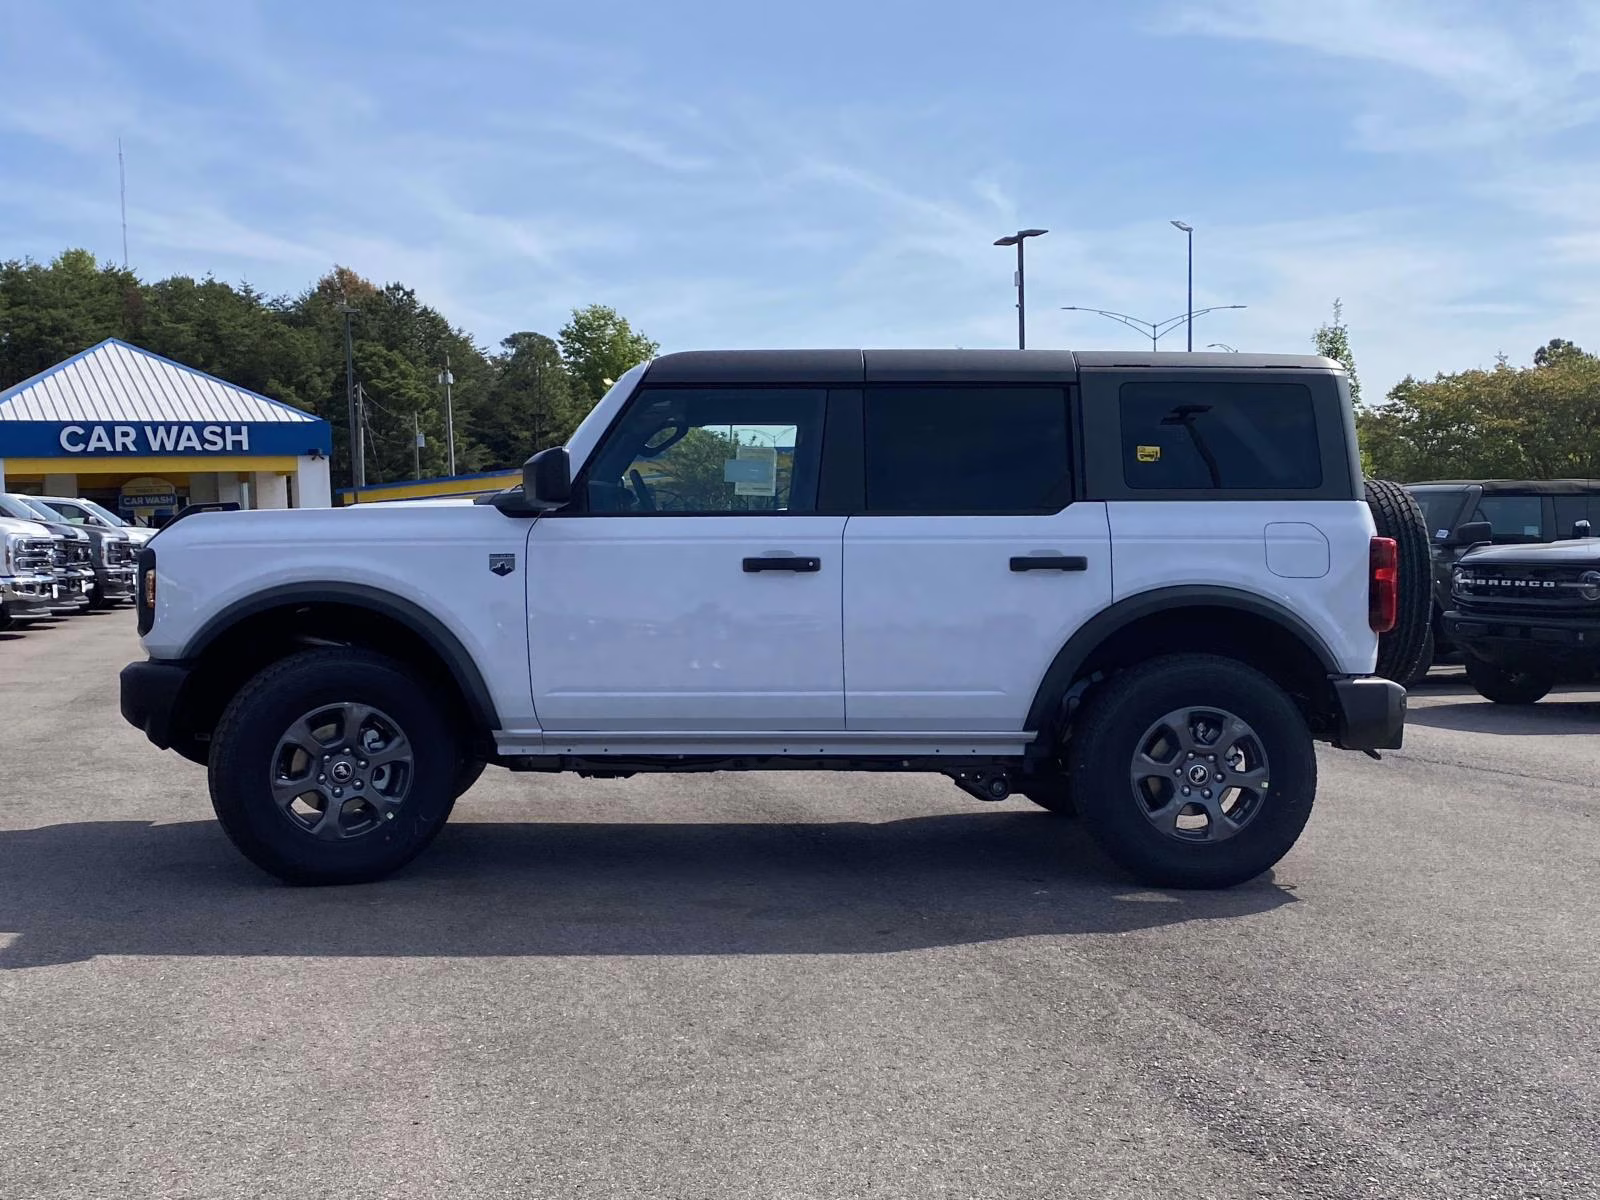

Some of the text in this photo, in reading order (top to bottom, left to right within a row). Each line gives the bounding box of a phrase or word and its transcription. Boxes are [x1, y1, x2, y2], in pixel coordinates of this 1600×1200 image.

[59, 425, 249, 453] CAR WASH
[123, 495, 173, 505] CAR WASH
[1476, 579, 1556, 588] BRONCO
